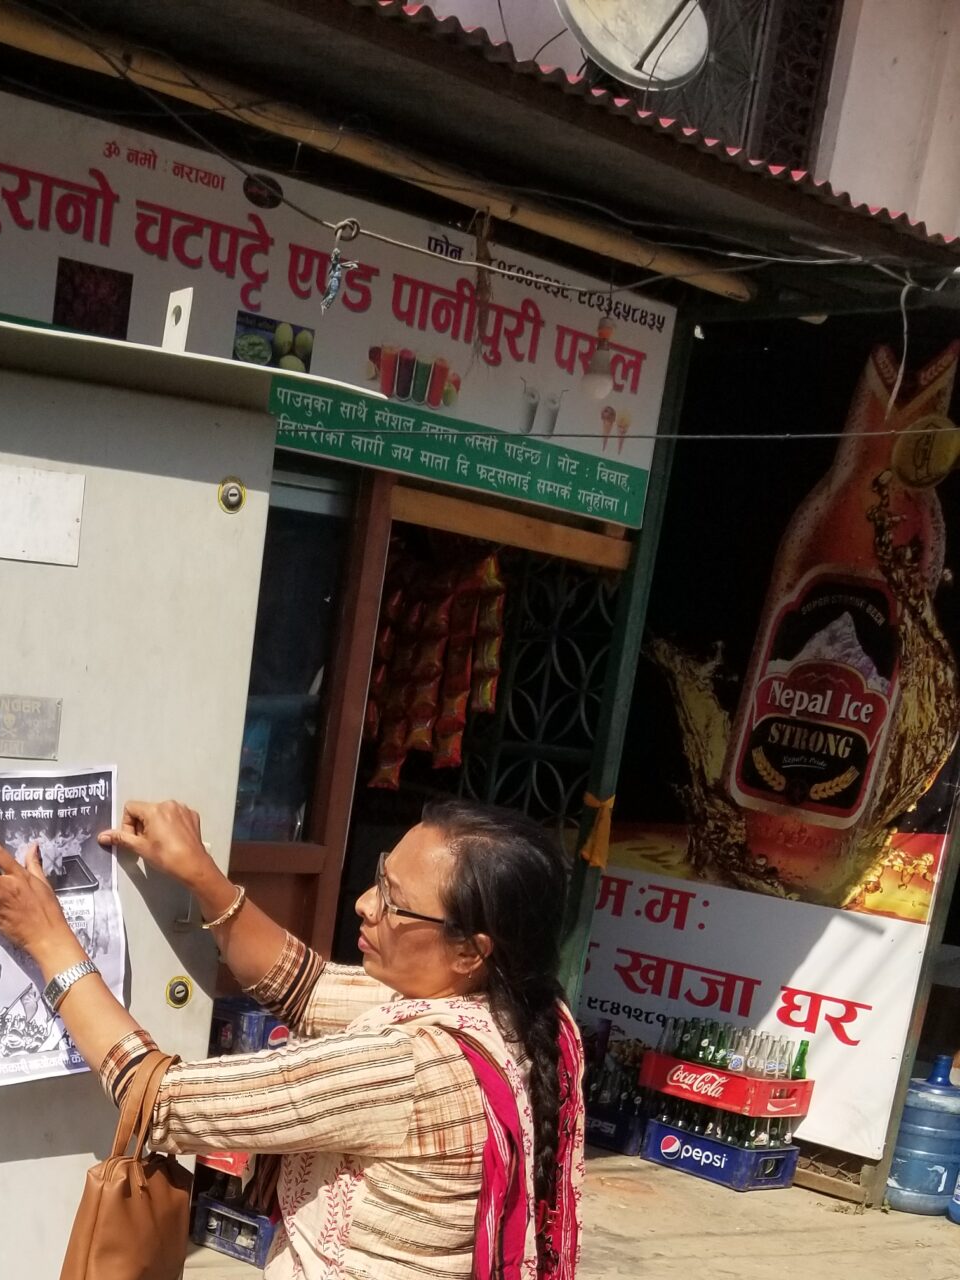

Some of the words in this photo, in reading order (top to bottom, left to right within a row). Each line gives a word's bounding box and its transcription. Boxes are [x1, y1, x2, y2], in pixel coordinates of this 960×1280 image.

[126, 148, 158, 170] नमो
[427, 234, 463, 261] फोन
[392, 273, 546, 367] पानीपुरी
[339, 399, 369, 423] साथै
[374, 407, 416, 433] स्पेशल
[557, 452, 580, 475] नोट
[391, 443, 414, 463] जय
[419, 450, 451, 472] माता
[767, 679, 833, 719] Nepal
[838, 693, 875, 724] Ice
[768, 721, 855, 760] STRONG
[1, 783, 44, 803] निर्वाचन
[586, 996, 668, 1028] ९८४१२८१
[614, 947, 762, 1018] खाजा
[775, 985, 873, 1047] घर
[680, 1143, 729, 1170] pepsi
